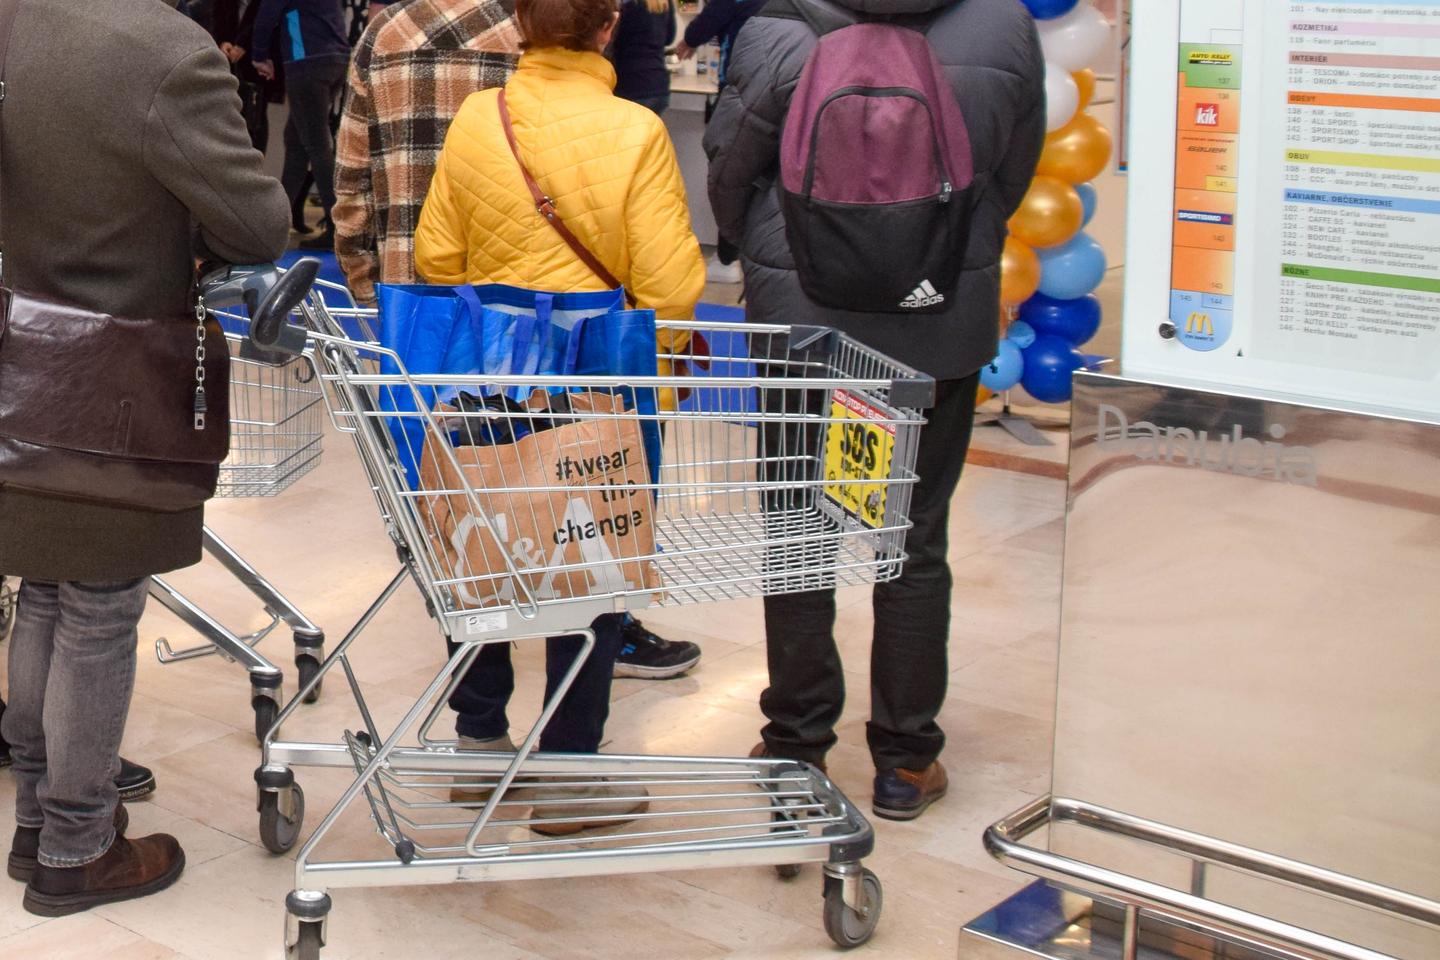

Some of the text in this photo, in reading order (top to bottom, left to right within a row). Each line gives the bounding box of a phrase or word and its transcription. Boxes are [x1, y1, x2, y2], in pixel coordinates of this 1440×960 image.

[1288, 152, 1310, 160] OBUV
[899, 293, 945, 308] adidas
[840, 420, 879, 472] SOS
[1097, 403, 1319, 487] Danubia
[556, 447, 630, 481] #wear
[599, 478, 637, 503] the
[553, 509, 643, 545] change
[450, 496, 635, 606] C&A
[119, 786, 150, 800] ASHION
